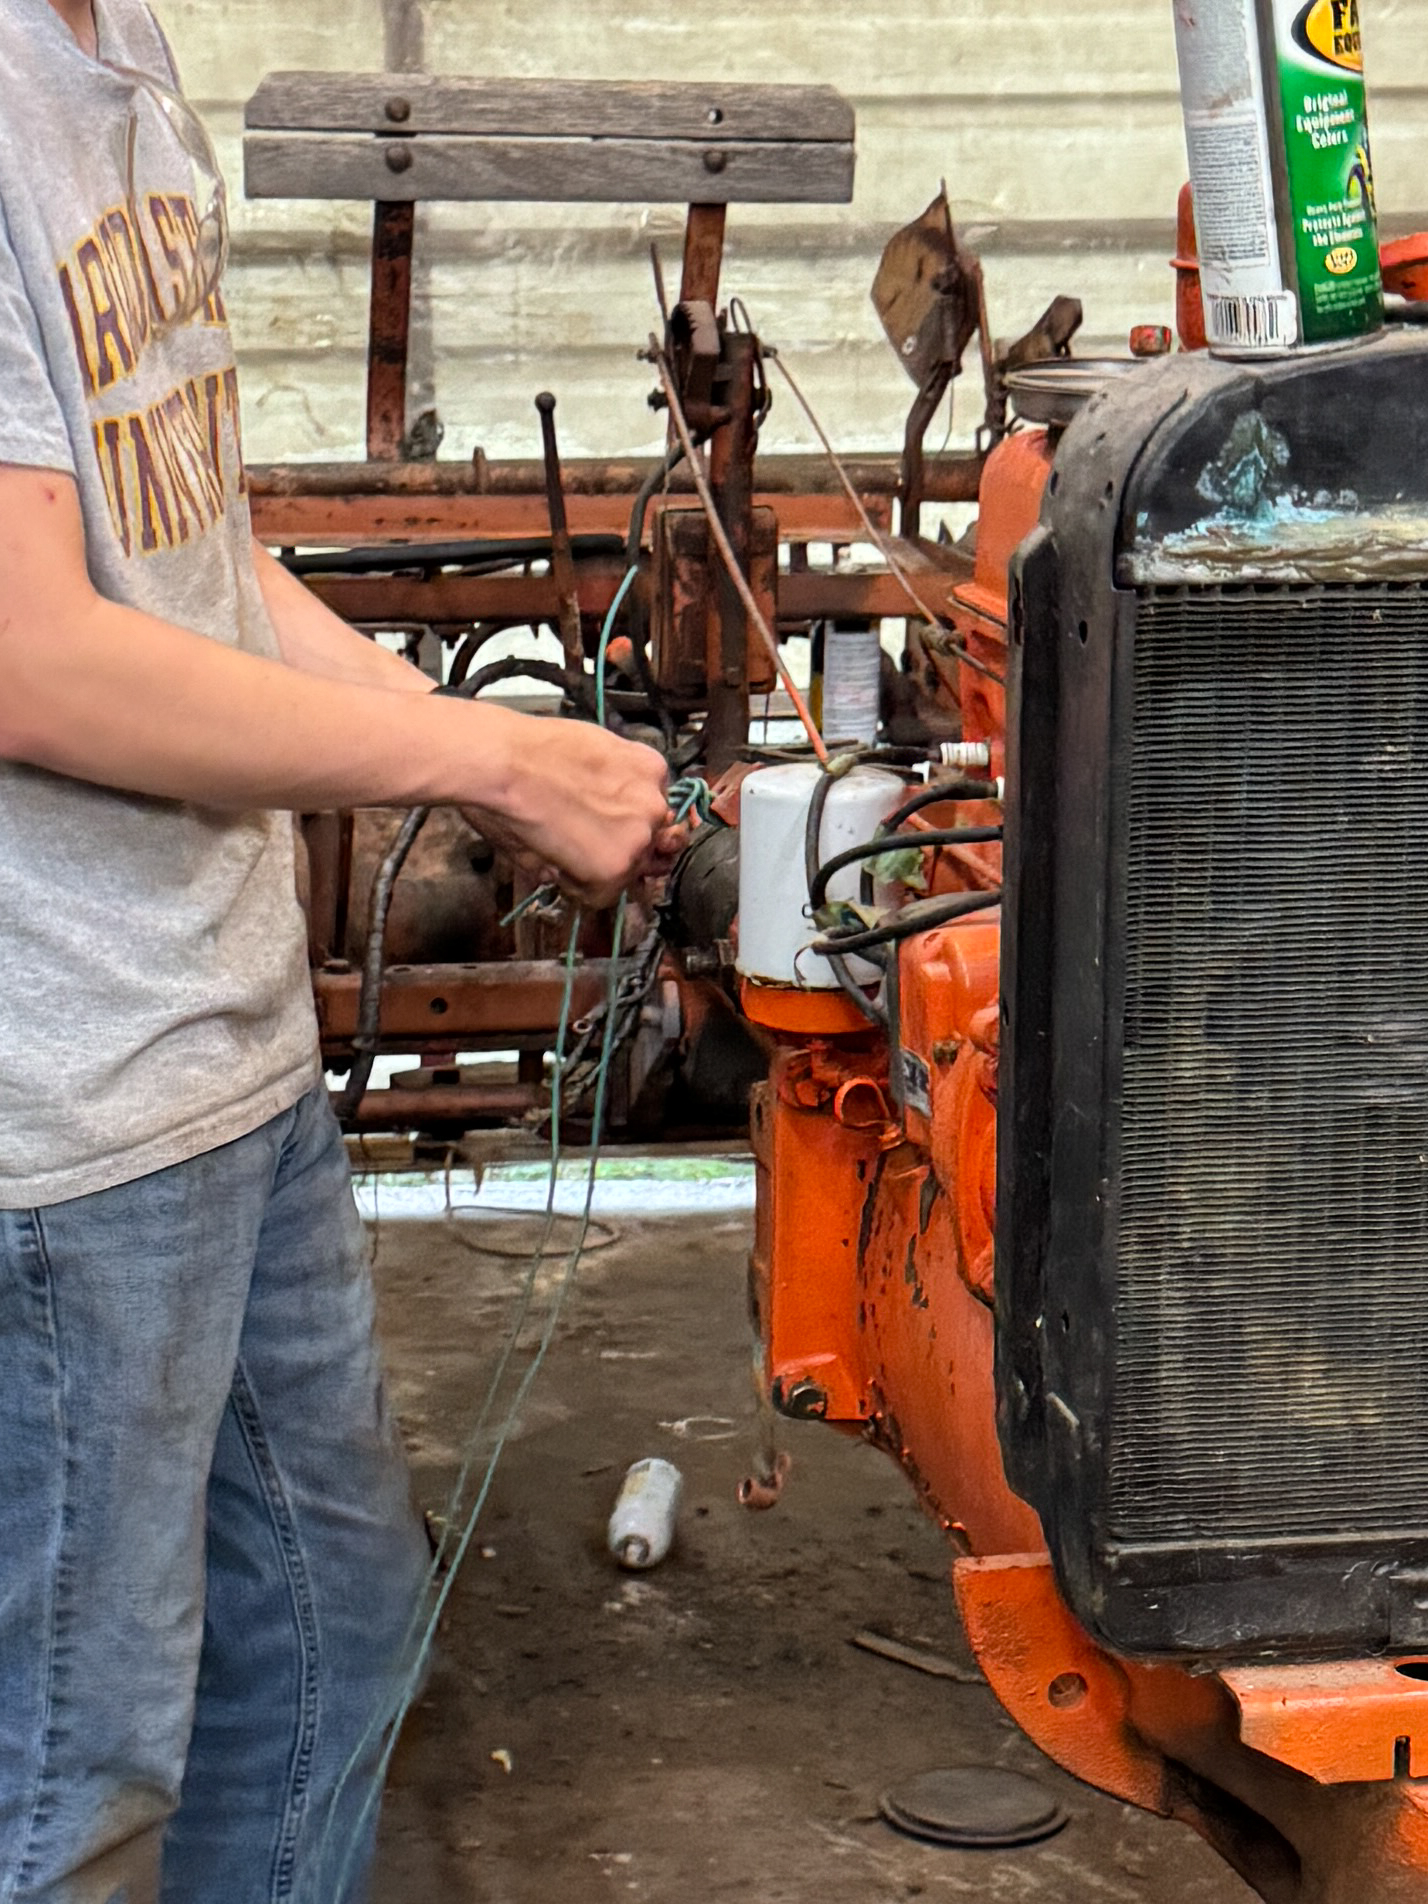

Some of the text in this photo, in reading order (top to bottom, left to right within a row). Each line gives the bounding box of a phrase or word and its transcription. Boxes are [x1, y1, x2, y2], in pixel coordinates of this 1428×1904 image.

[1303, 88, 1348, 114] Original
[1296, 108, 1355, 134] Equipment
[1311, 129, 1348, 150] Colors
